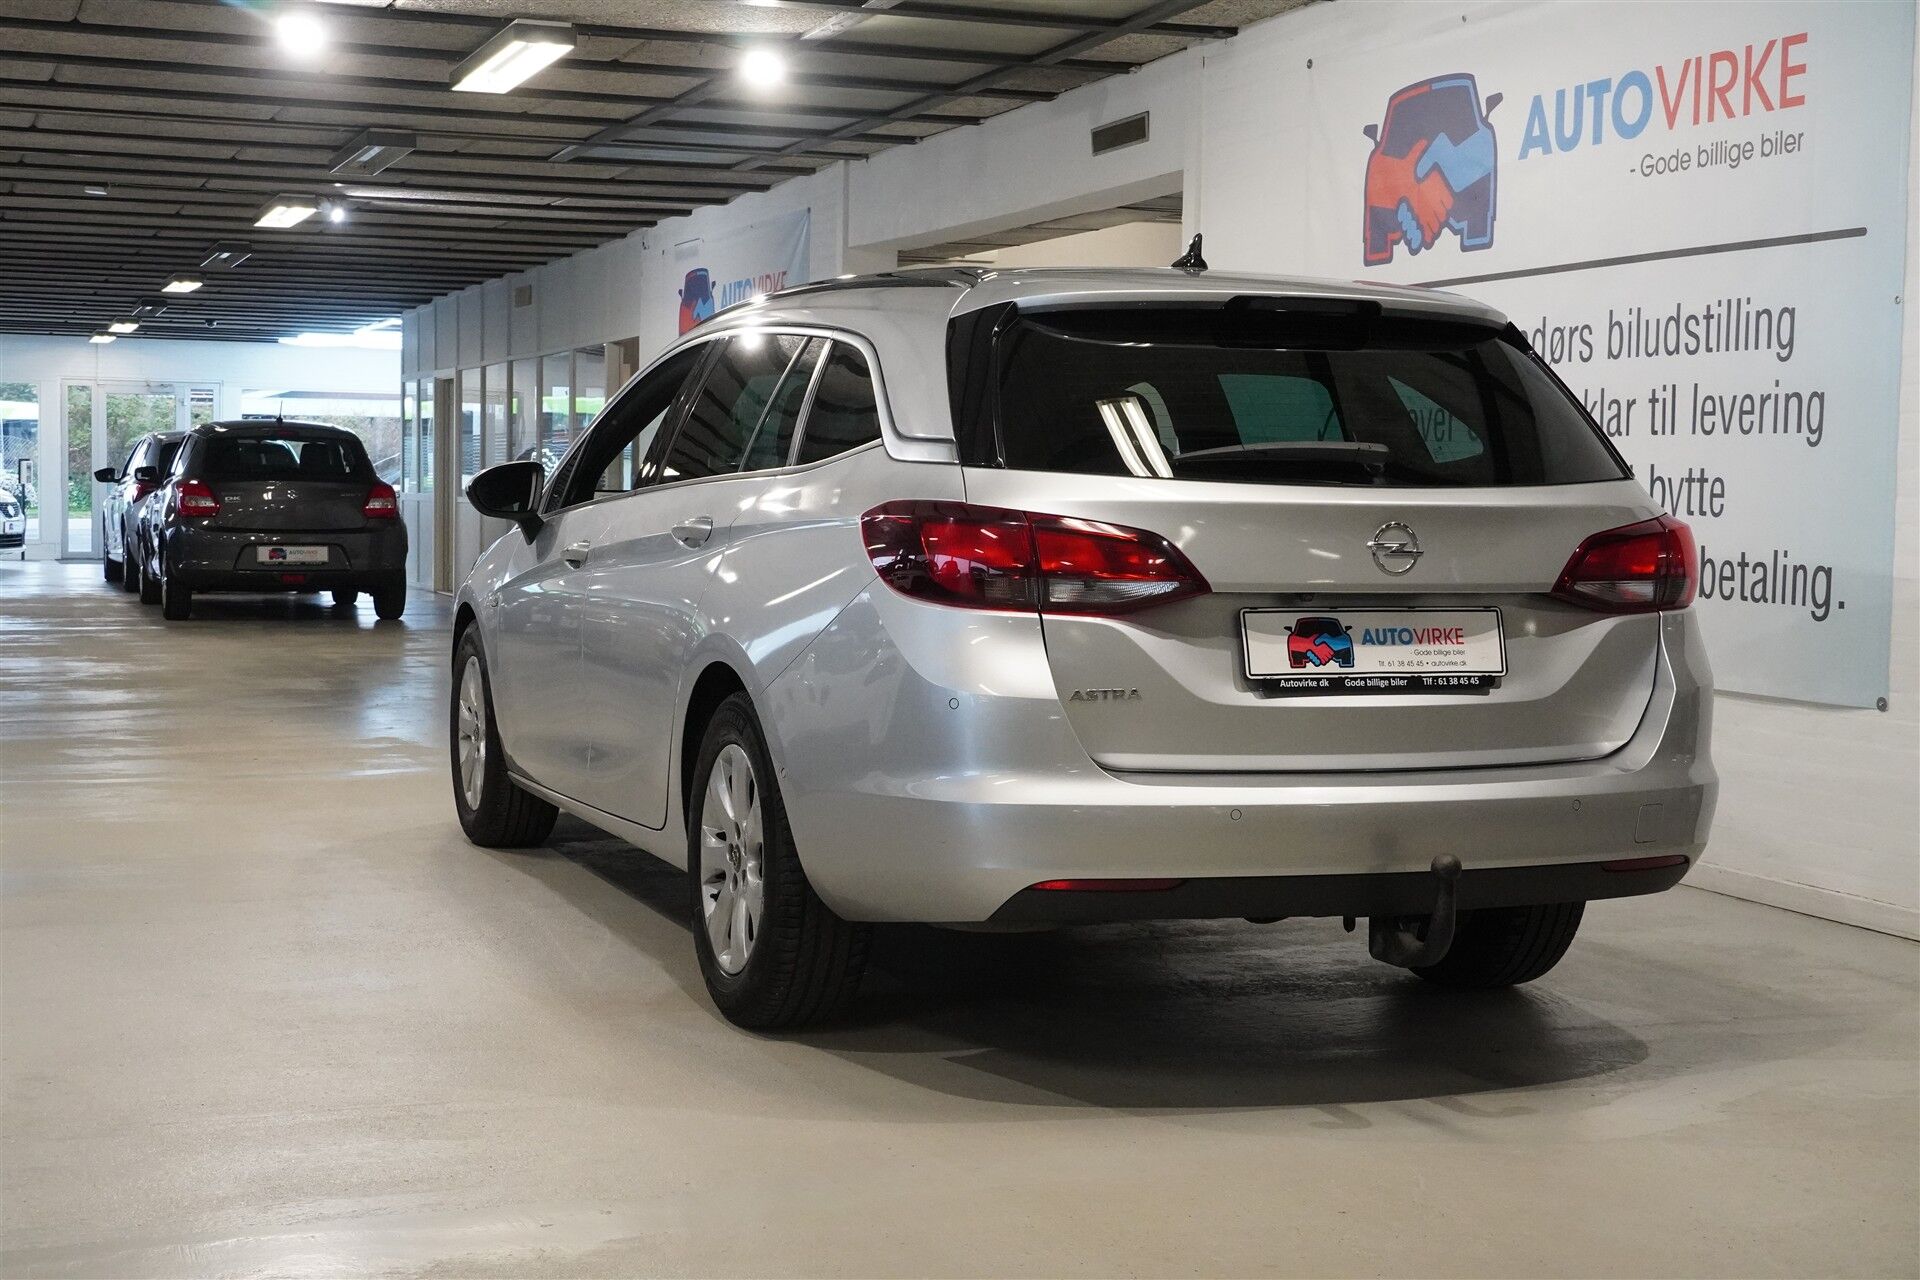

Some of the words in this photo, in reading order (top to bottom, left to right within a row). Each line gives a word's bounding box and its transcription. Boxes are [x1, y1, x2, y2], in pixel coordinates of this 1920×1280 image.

[1518, 32, 1808, 160] AUTOVIRKE
[1640, 147, 1691, 177] Gode
[1697, 140, 1754, 169] billige
[1761, 130, 1805, 158] biler
[1607, 297, 1796, 362] biludstilling
[1648, 384, 1677, 436] til
[1691, 380, 1826, 448] levering
[1698, 545, 1845, 622] betaling.
[1361, 627, 1465, 646] AUTOVIRKE
[1069, 687, 1143, 702] ASTRA
[1280, 679, 1317, 688] Autovirke
[1344, 678, 1365, 687] Gode
[1366, 678, 1389, 688] billige
[1390, 677, 1408, 686] biler
[1438, 677, 1447, 685] 61
[1449, 677, 1458, 685] 38
[1470, 676, 1479, 684] 45
